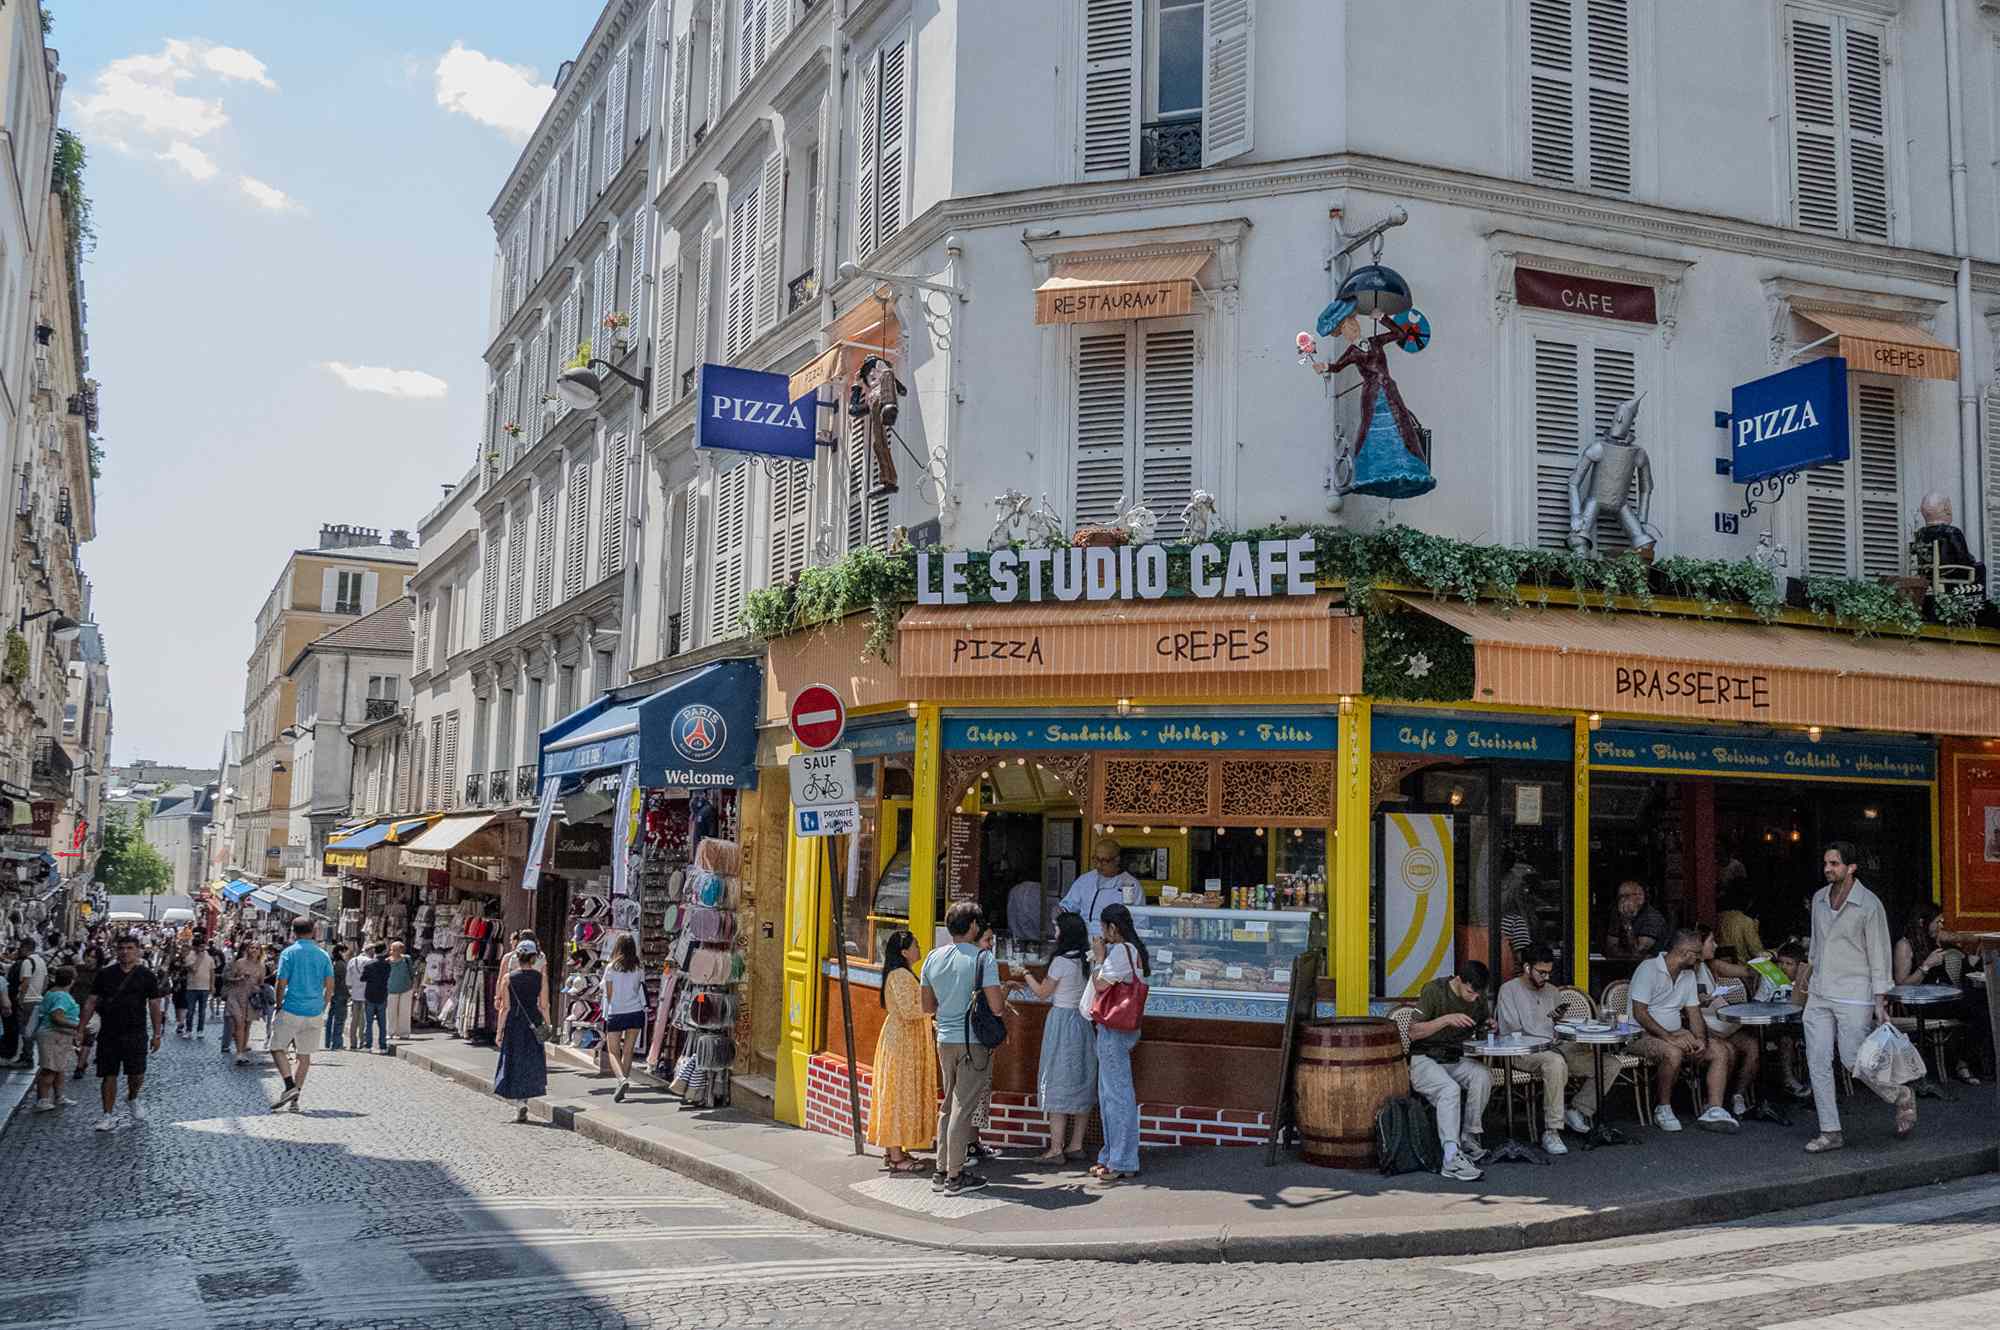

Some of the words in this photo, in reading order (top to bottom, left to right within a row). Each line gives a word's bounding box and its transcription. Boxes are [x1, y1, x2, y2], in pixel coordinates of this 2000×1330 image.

[1053, 289, 1172, 315] RESTAURANT
[1560, 288, 1615, 314] CAFE
[1874, 349, 1925, 369] CREPES
[711, 394, 807, 430] PIZZA
[1736, 399, 1819, 448] PIZZA
[1717, 514, 1735, 533] 15
[916, 551, 968, 605] LE
[989, 544, 1168, 602] STUDIO
[1190, 533, 1316, 598] CAFÉ
[953, 636, 1044, 665] PIZZA
[1156, 629, 1270, 662] CREPES
[1615, 667, 1770, 708] BRASSERIE
[682, 707, 720, 724] PARIS
[1399, 727, 1436, 750] Café
[1593, 740, 1636, 758] Pizza
[803, 755, 837, 770] SAUF
[664, 769, 735, 785] Welcome
